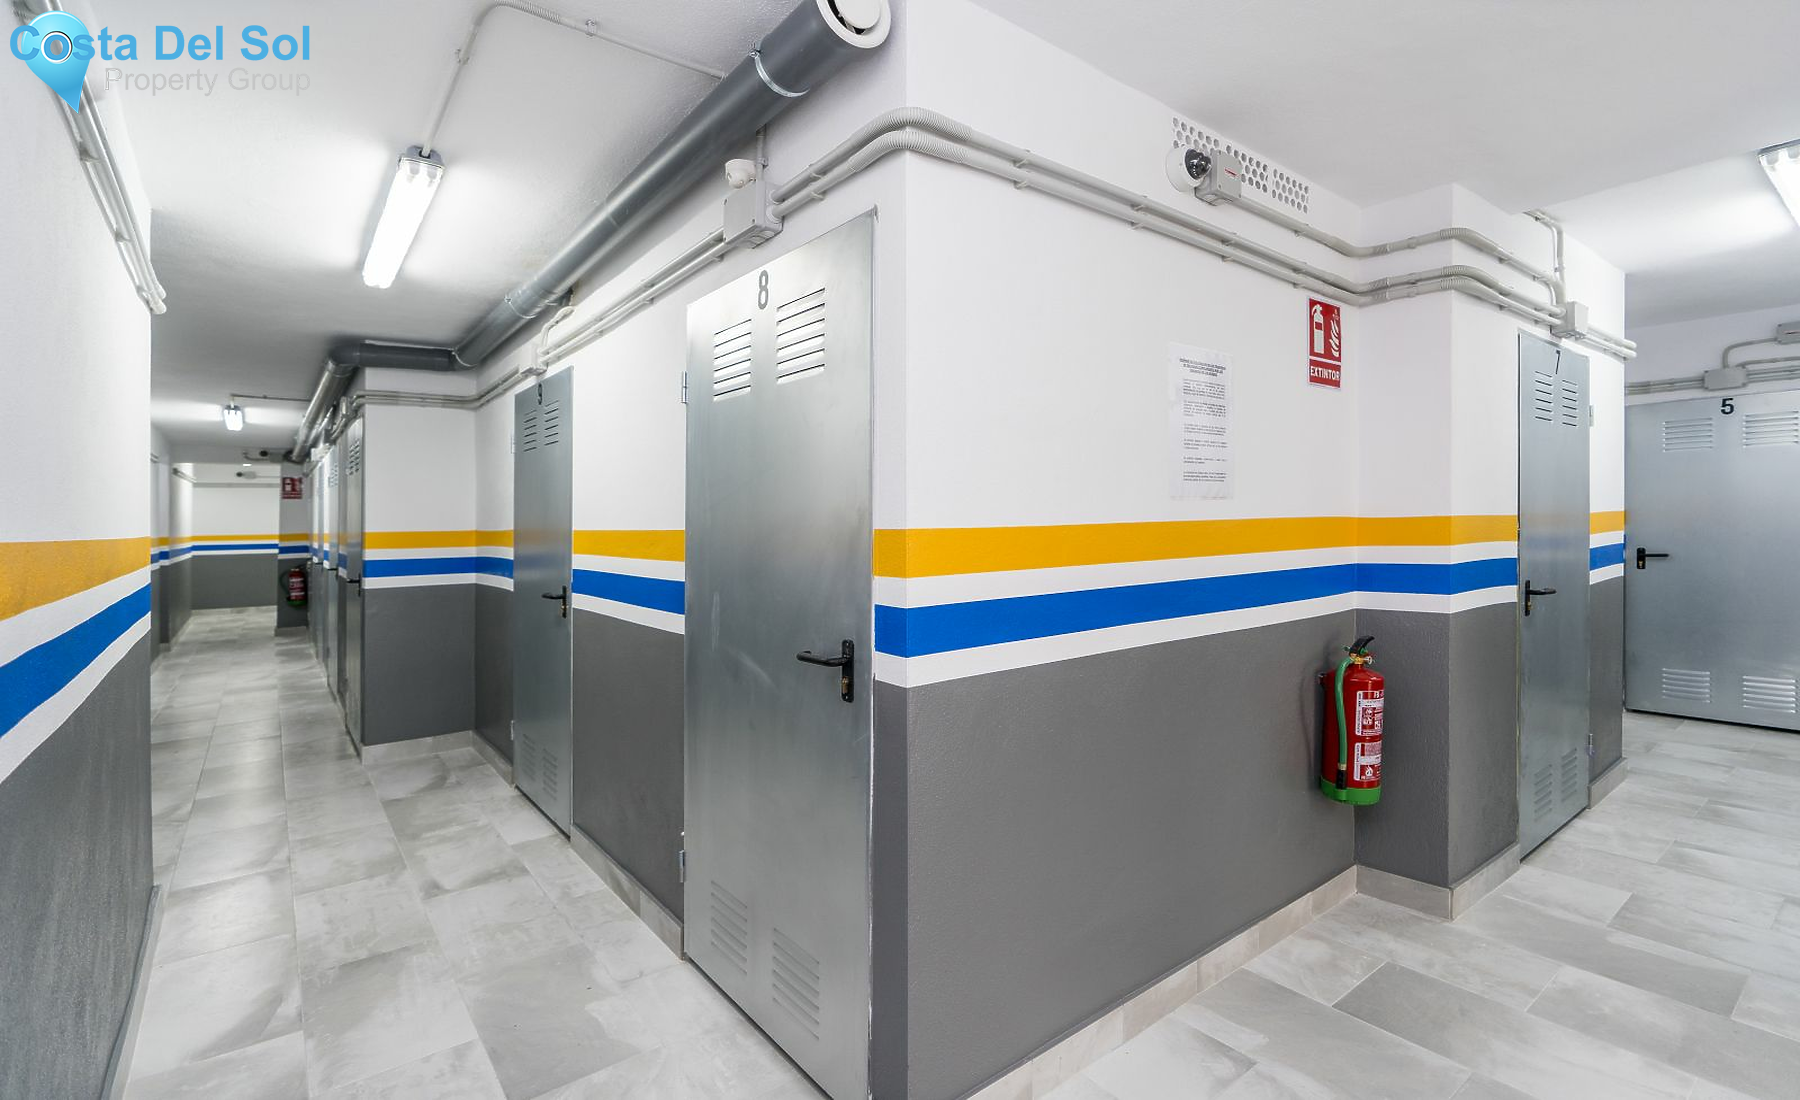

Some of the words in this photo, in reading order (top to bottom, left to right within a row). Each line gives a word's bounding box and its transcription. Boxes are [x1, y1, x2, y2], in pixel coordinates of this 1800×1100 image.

[758, 270, 768, 310] 8
[1310, 366, 1340, 380] EXTINTOR
[1556, 350, 1561, 375] 7
[1720, 397, 1734, 415] 5
